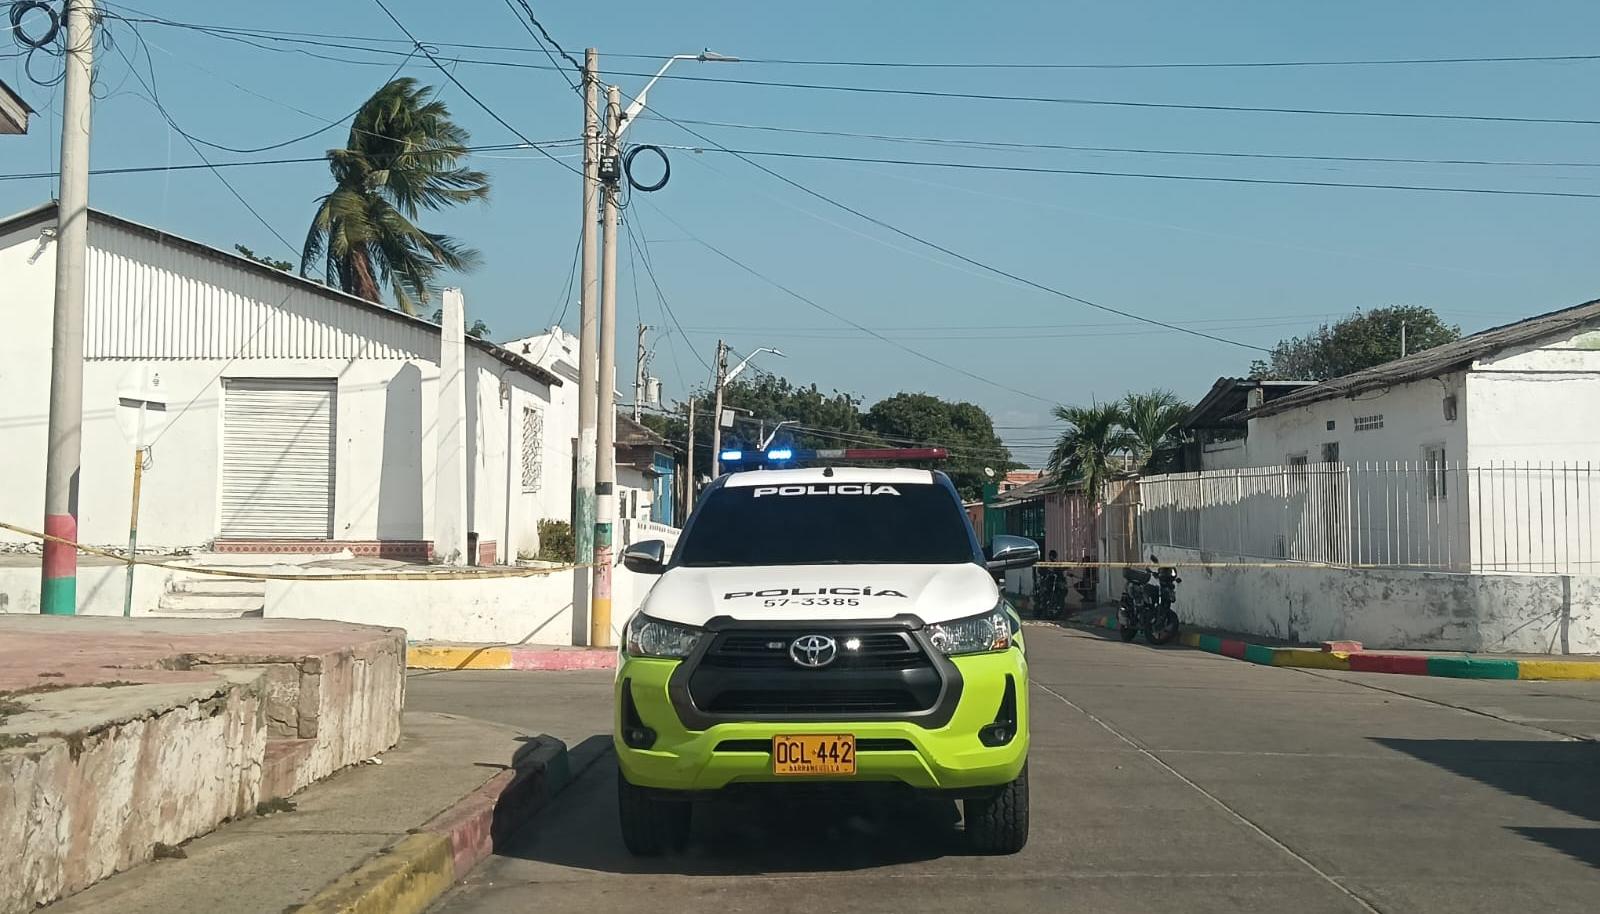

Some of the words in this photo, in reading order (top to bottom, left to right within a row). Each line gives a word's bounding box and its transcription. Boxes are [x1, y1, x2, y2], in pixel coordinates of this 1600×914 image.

[753, 482, 902, 498] POLICÍA
[724, 586, 908, 600] POLICÍA
[763, 598, 860, 608] 57-3385
[776, 741, 812, 764] OCL
[817, 741, 852, 764] 442
